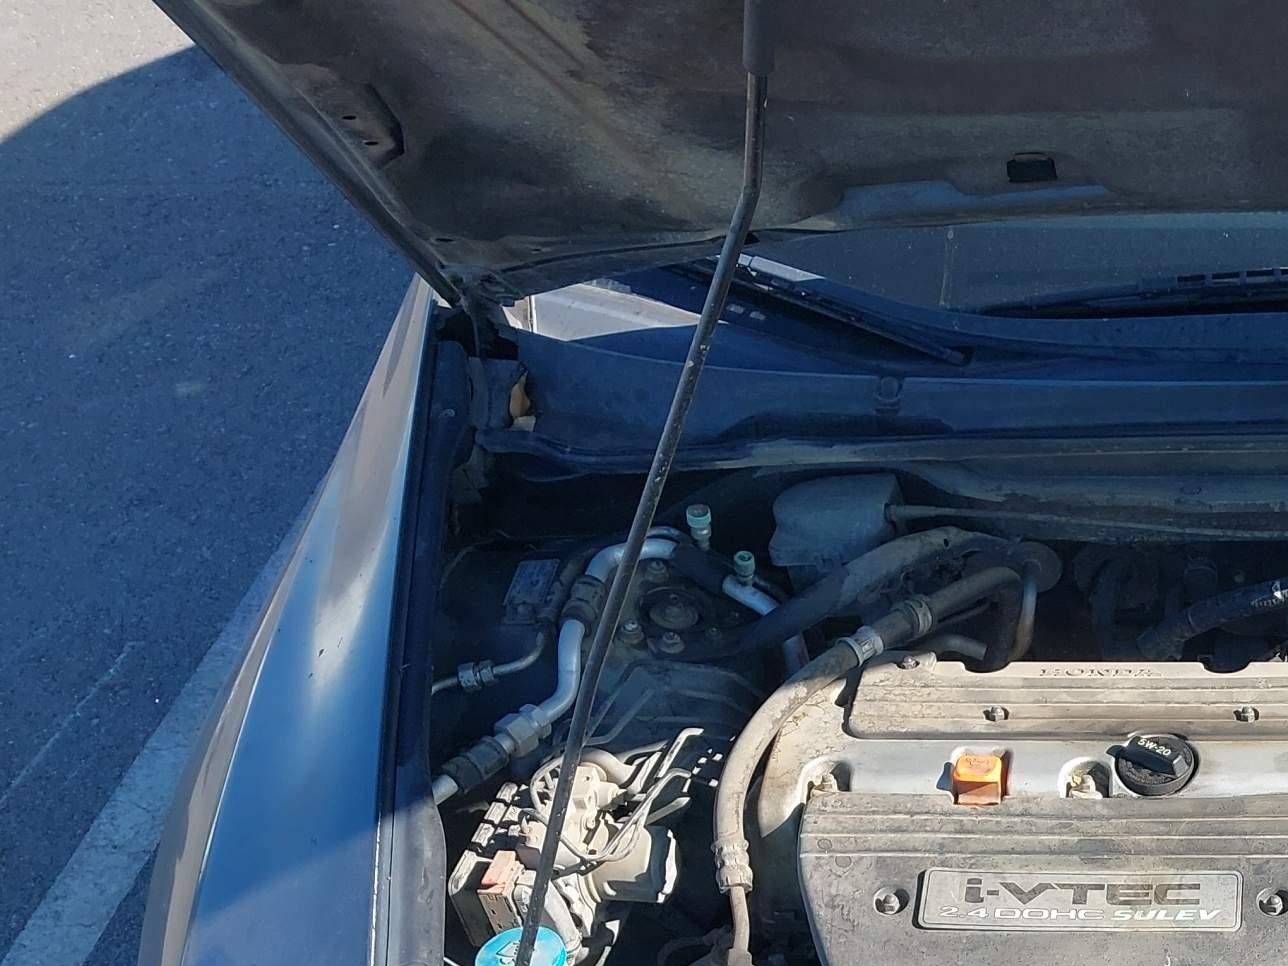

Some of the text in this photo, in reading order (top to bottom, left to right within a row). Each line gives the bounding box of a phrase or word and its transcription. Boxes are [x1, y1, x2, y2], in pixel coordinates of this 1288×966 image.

[1039, 667, 1162, 677] HONDA
[1137, 738, 1172, 757] 5W-20
[964, 877, 1201, 906] i-VTEC
[994, 907, 1105, 920] DOHC
[1110, 908, 1223, 921] SULEV
